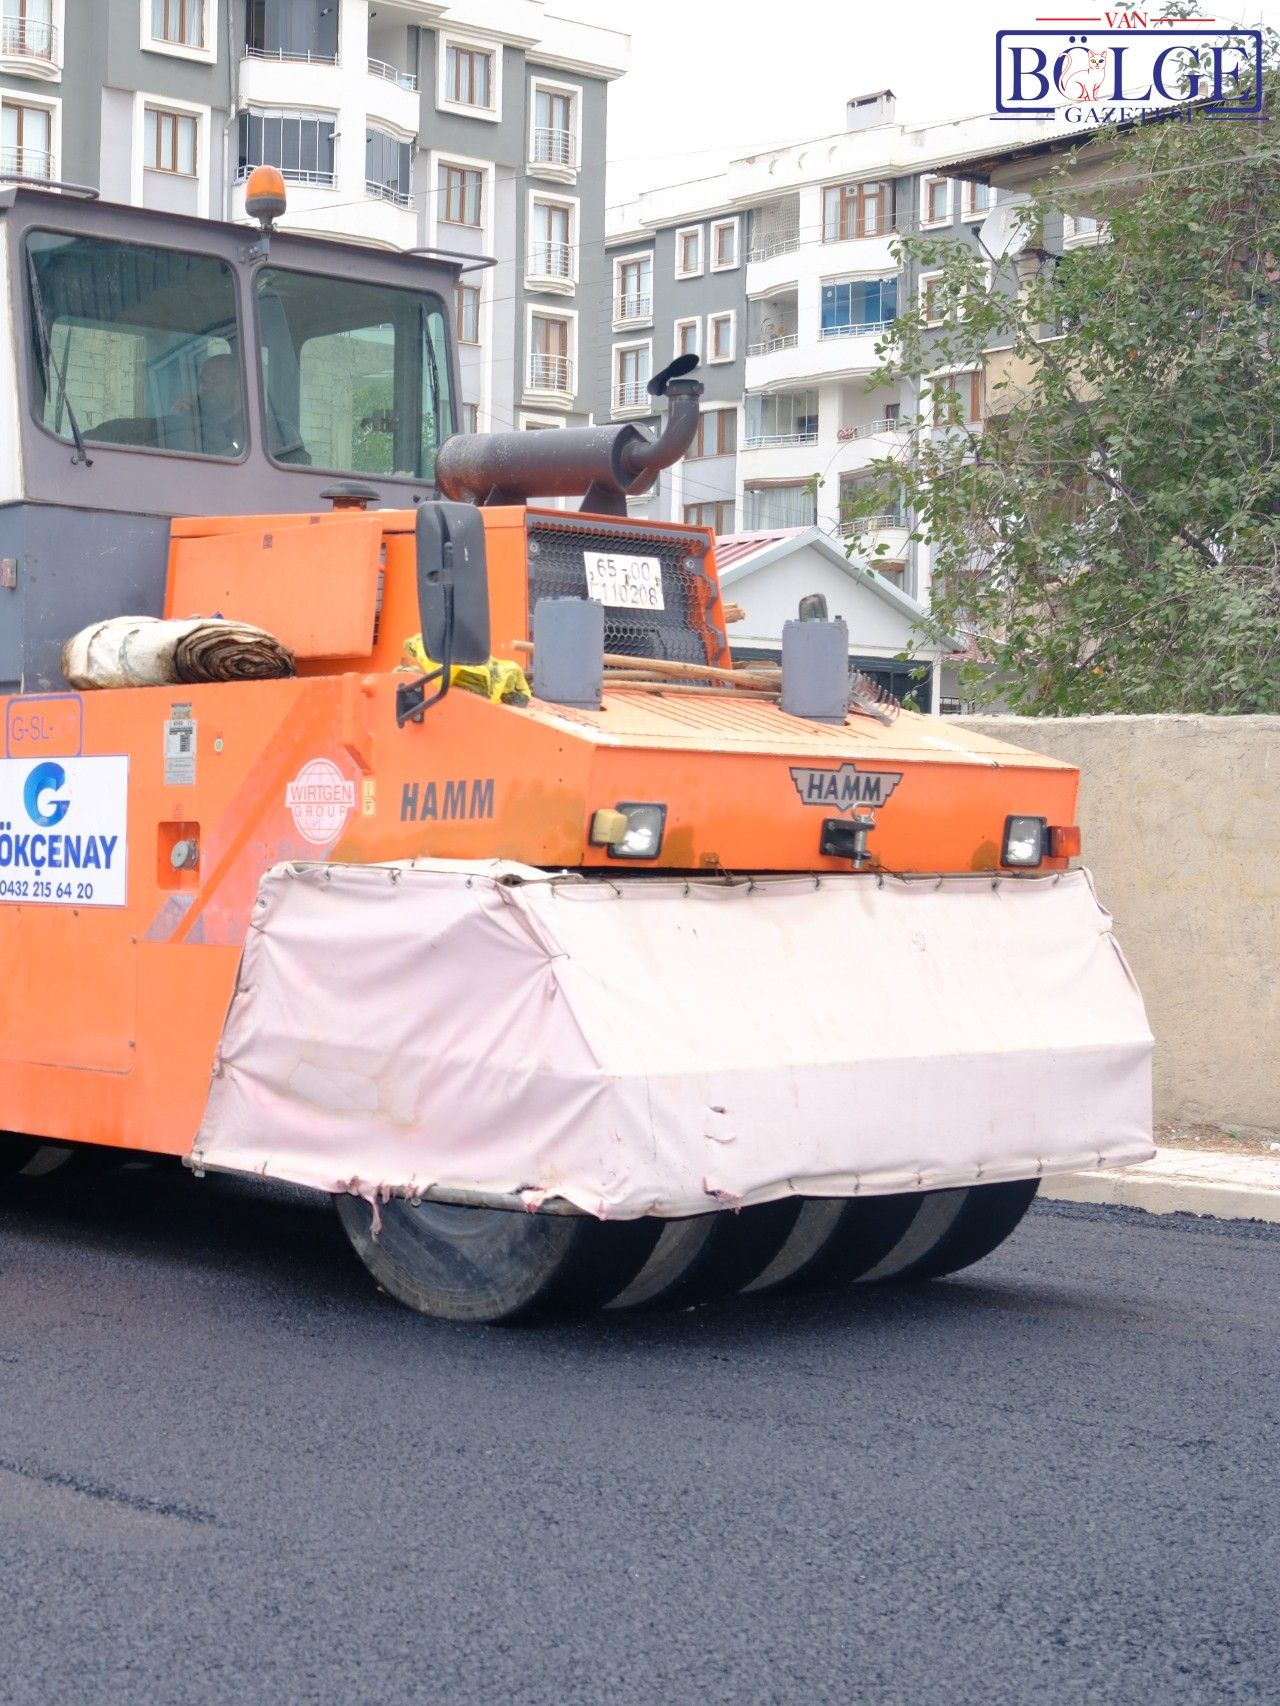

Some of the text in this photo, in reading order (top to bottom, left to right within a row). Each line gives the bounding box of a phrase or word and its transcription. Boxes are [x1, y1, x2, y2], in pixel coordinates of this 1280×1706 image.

[290, 785, 351, 801] WIRTGEN
[806, 773, 881, 801] HAMM
[400, 779, 495, 821] HAMM
[294, 806, 345, 817] GROUP
[0, 880, 93, 899] 0432 215 64 20
